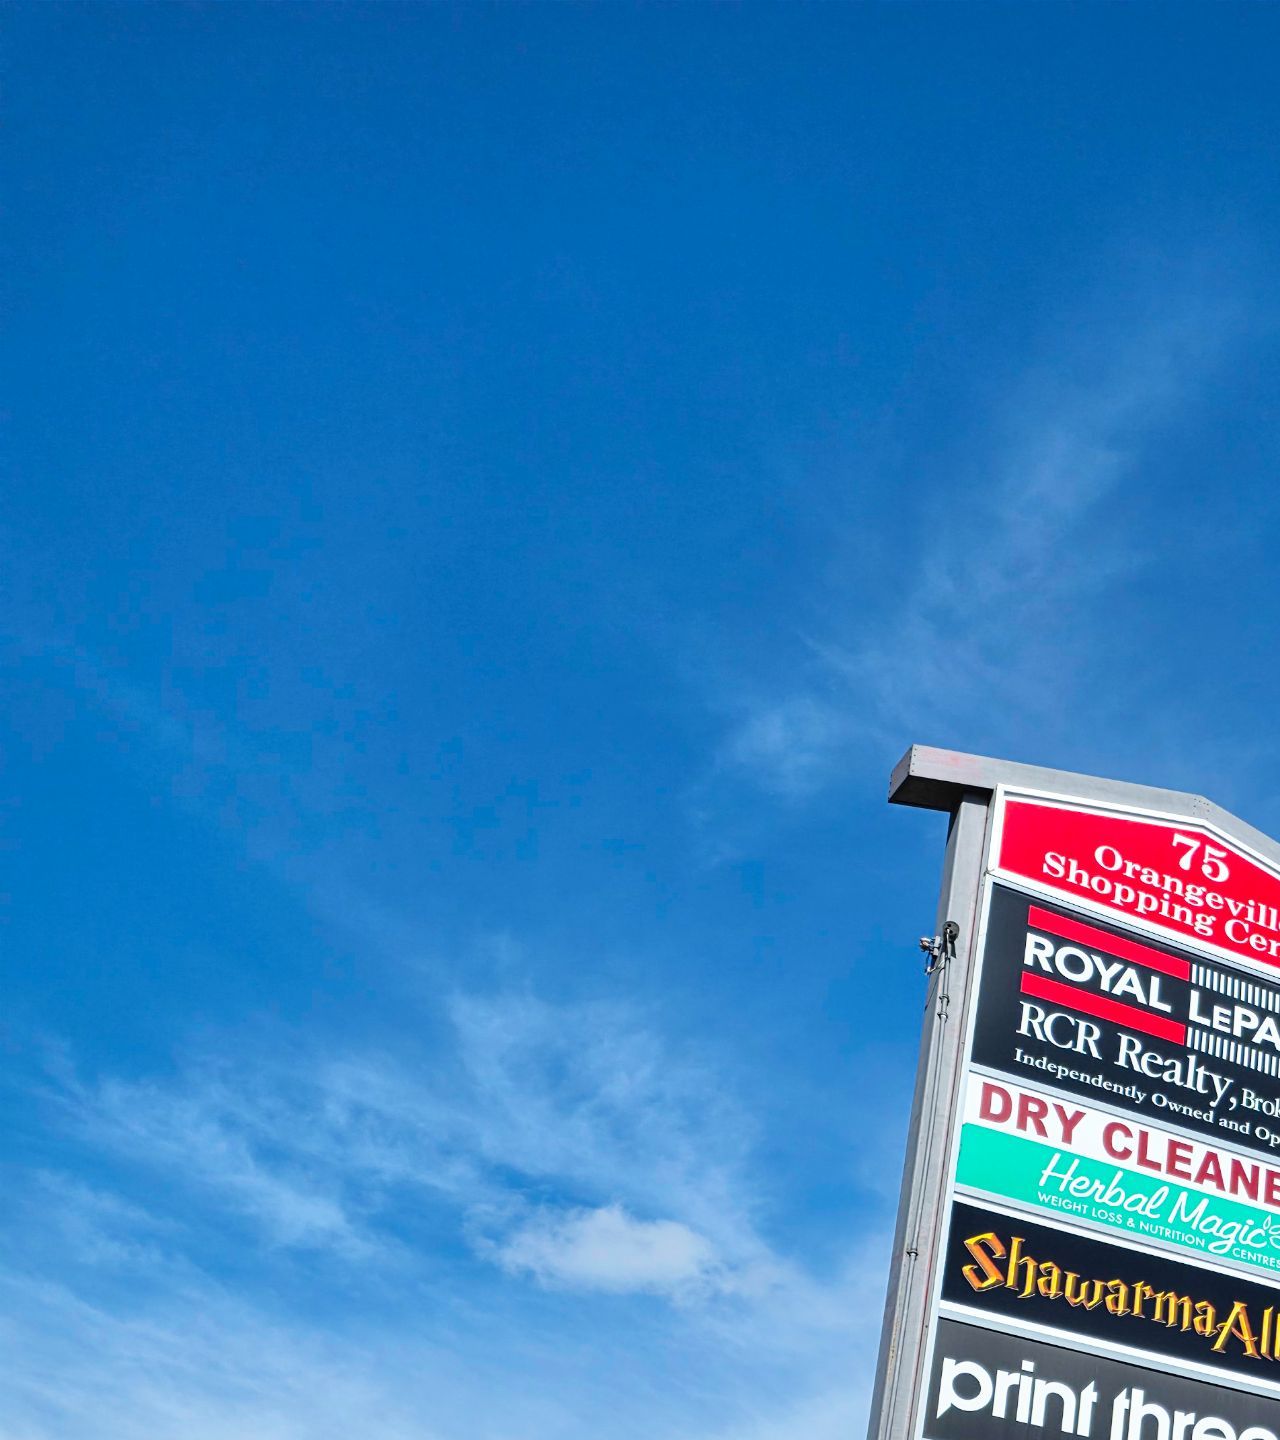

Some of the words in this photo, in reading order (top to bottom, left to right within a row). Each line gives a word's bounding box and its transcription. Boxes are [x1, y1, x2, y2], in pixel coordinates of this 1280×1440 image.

[1042, 852, 1217, 937] Shopping
[1172, 833, 1230, 883] 75
[1022, 932, 1172, 1013] ROYAL
[1014, 1048, 1147, 1104] Independently
[1152, 1093, 1214, 1127] Owned
[1219, 1110, 1251, 1134] and
[1016, 1001, 1102, 1061] RCR
[1114, 1033, 1238, 1111] Realty,
[979, 1081, 1086, 1145] DRY
[1037, 1190, 1089, 1214] WEIGHT
[1092, 1205, 1123, 1224] LOSS
[1127, 1216, 1136, 1228] &
[1139, 1220, 1206, 1247] NUTRITION
[1038, 1153, 1169, 1220] Herbal
[1167, 1194, 1267, 1254] Magic
[936, 1355, 1098, 1438] print
